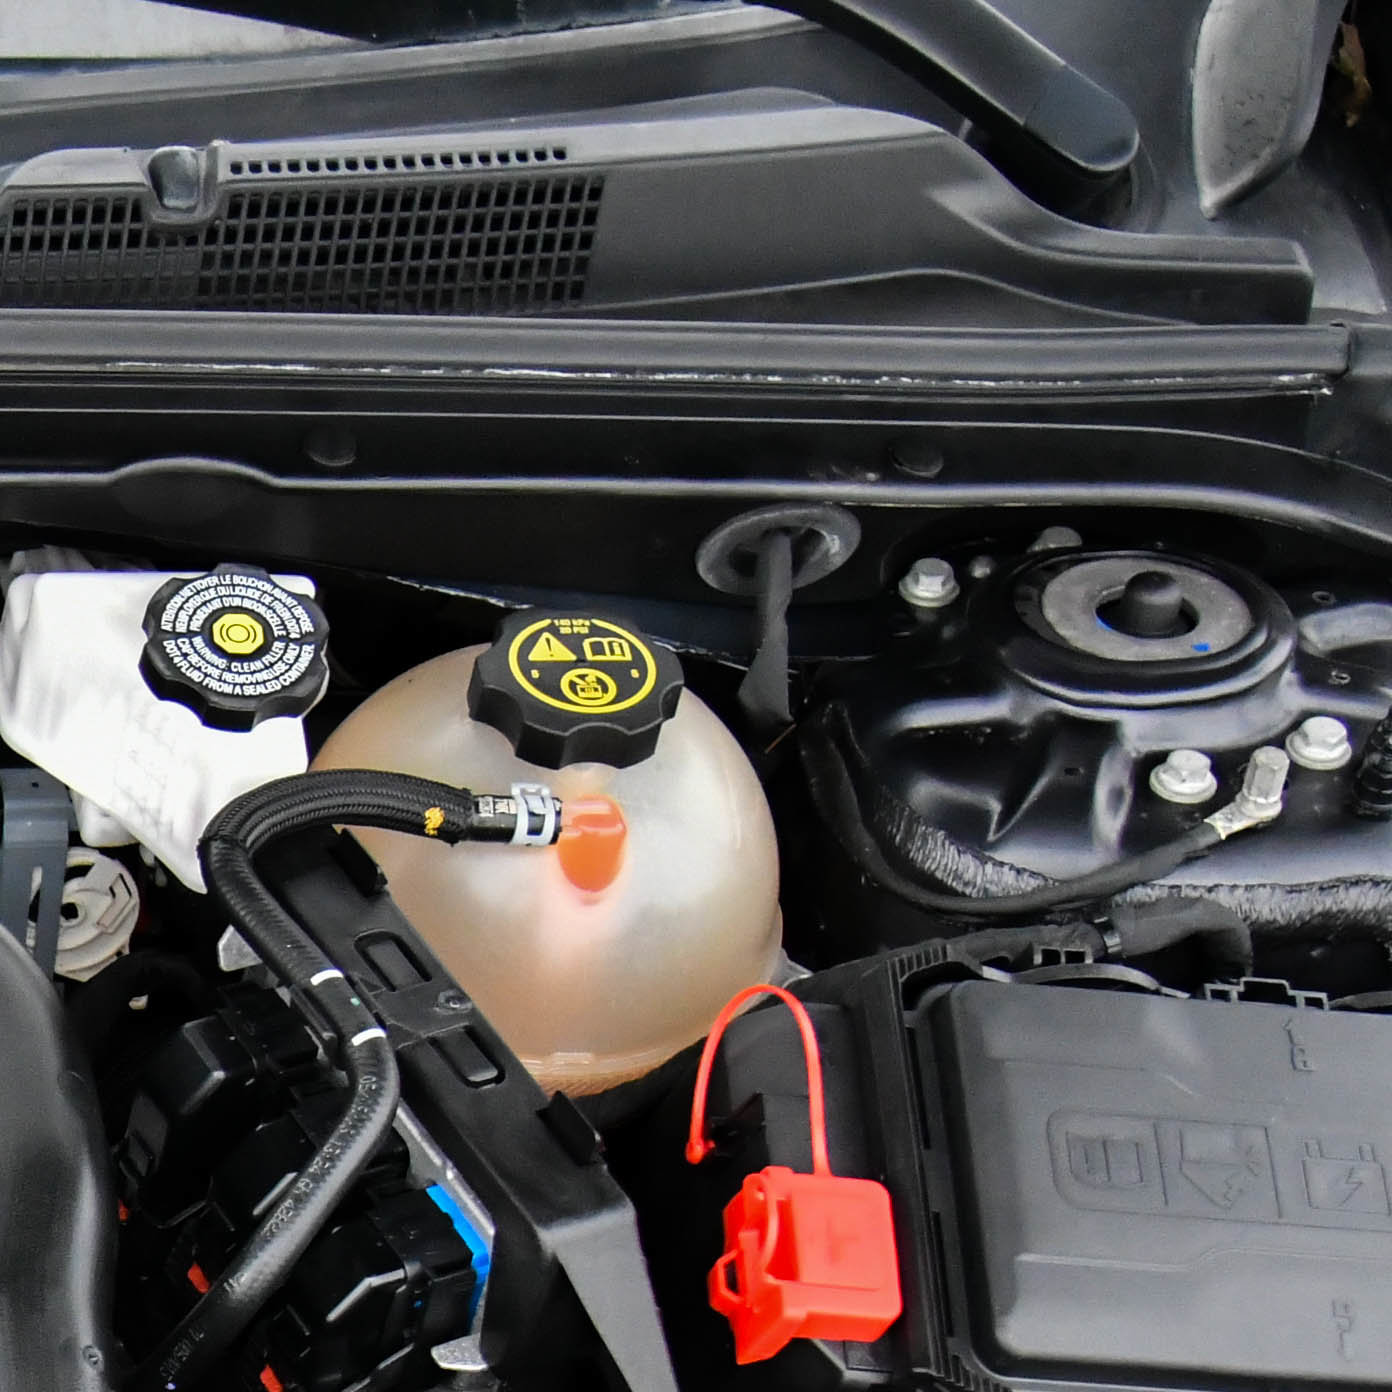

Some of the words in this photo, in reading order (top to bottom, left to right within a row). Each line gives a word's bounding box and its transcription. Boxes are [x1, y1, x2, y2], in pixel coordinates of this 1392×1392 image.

[220, 574, 232, 585] LE
[176, 638, 195, 656] CAP
[230, 659, 266, 672] CLEAN
[263, 641, 285, 668] FILLER
[176, 659, 206, 684] FLUID
[203, 676, 233, 693] FROM
[243, 680, 283, 696] SEALED
[185, 652, 223, 679] BEFORE
